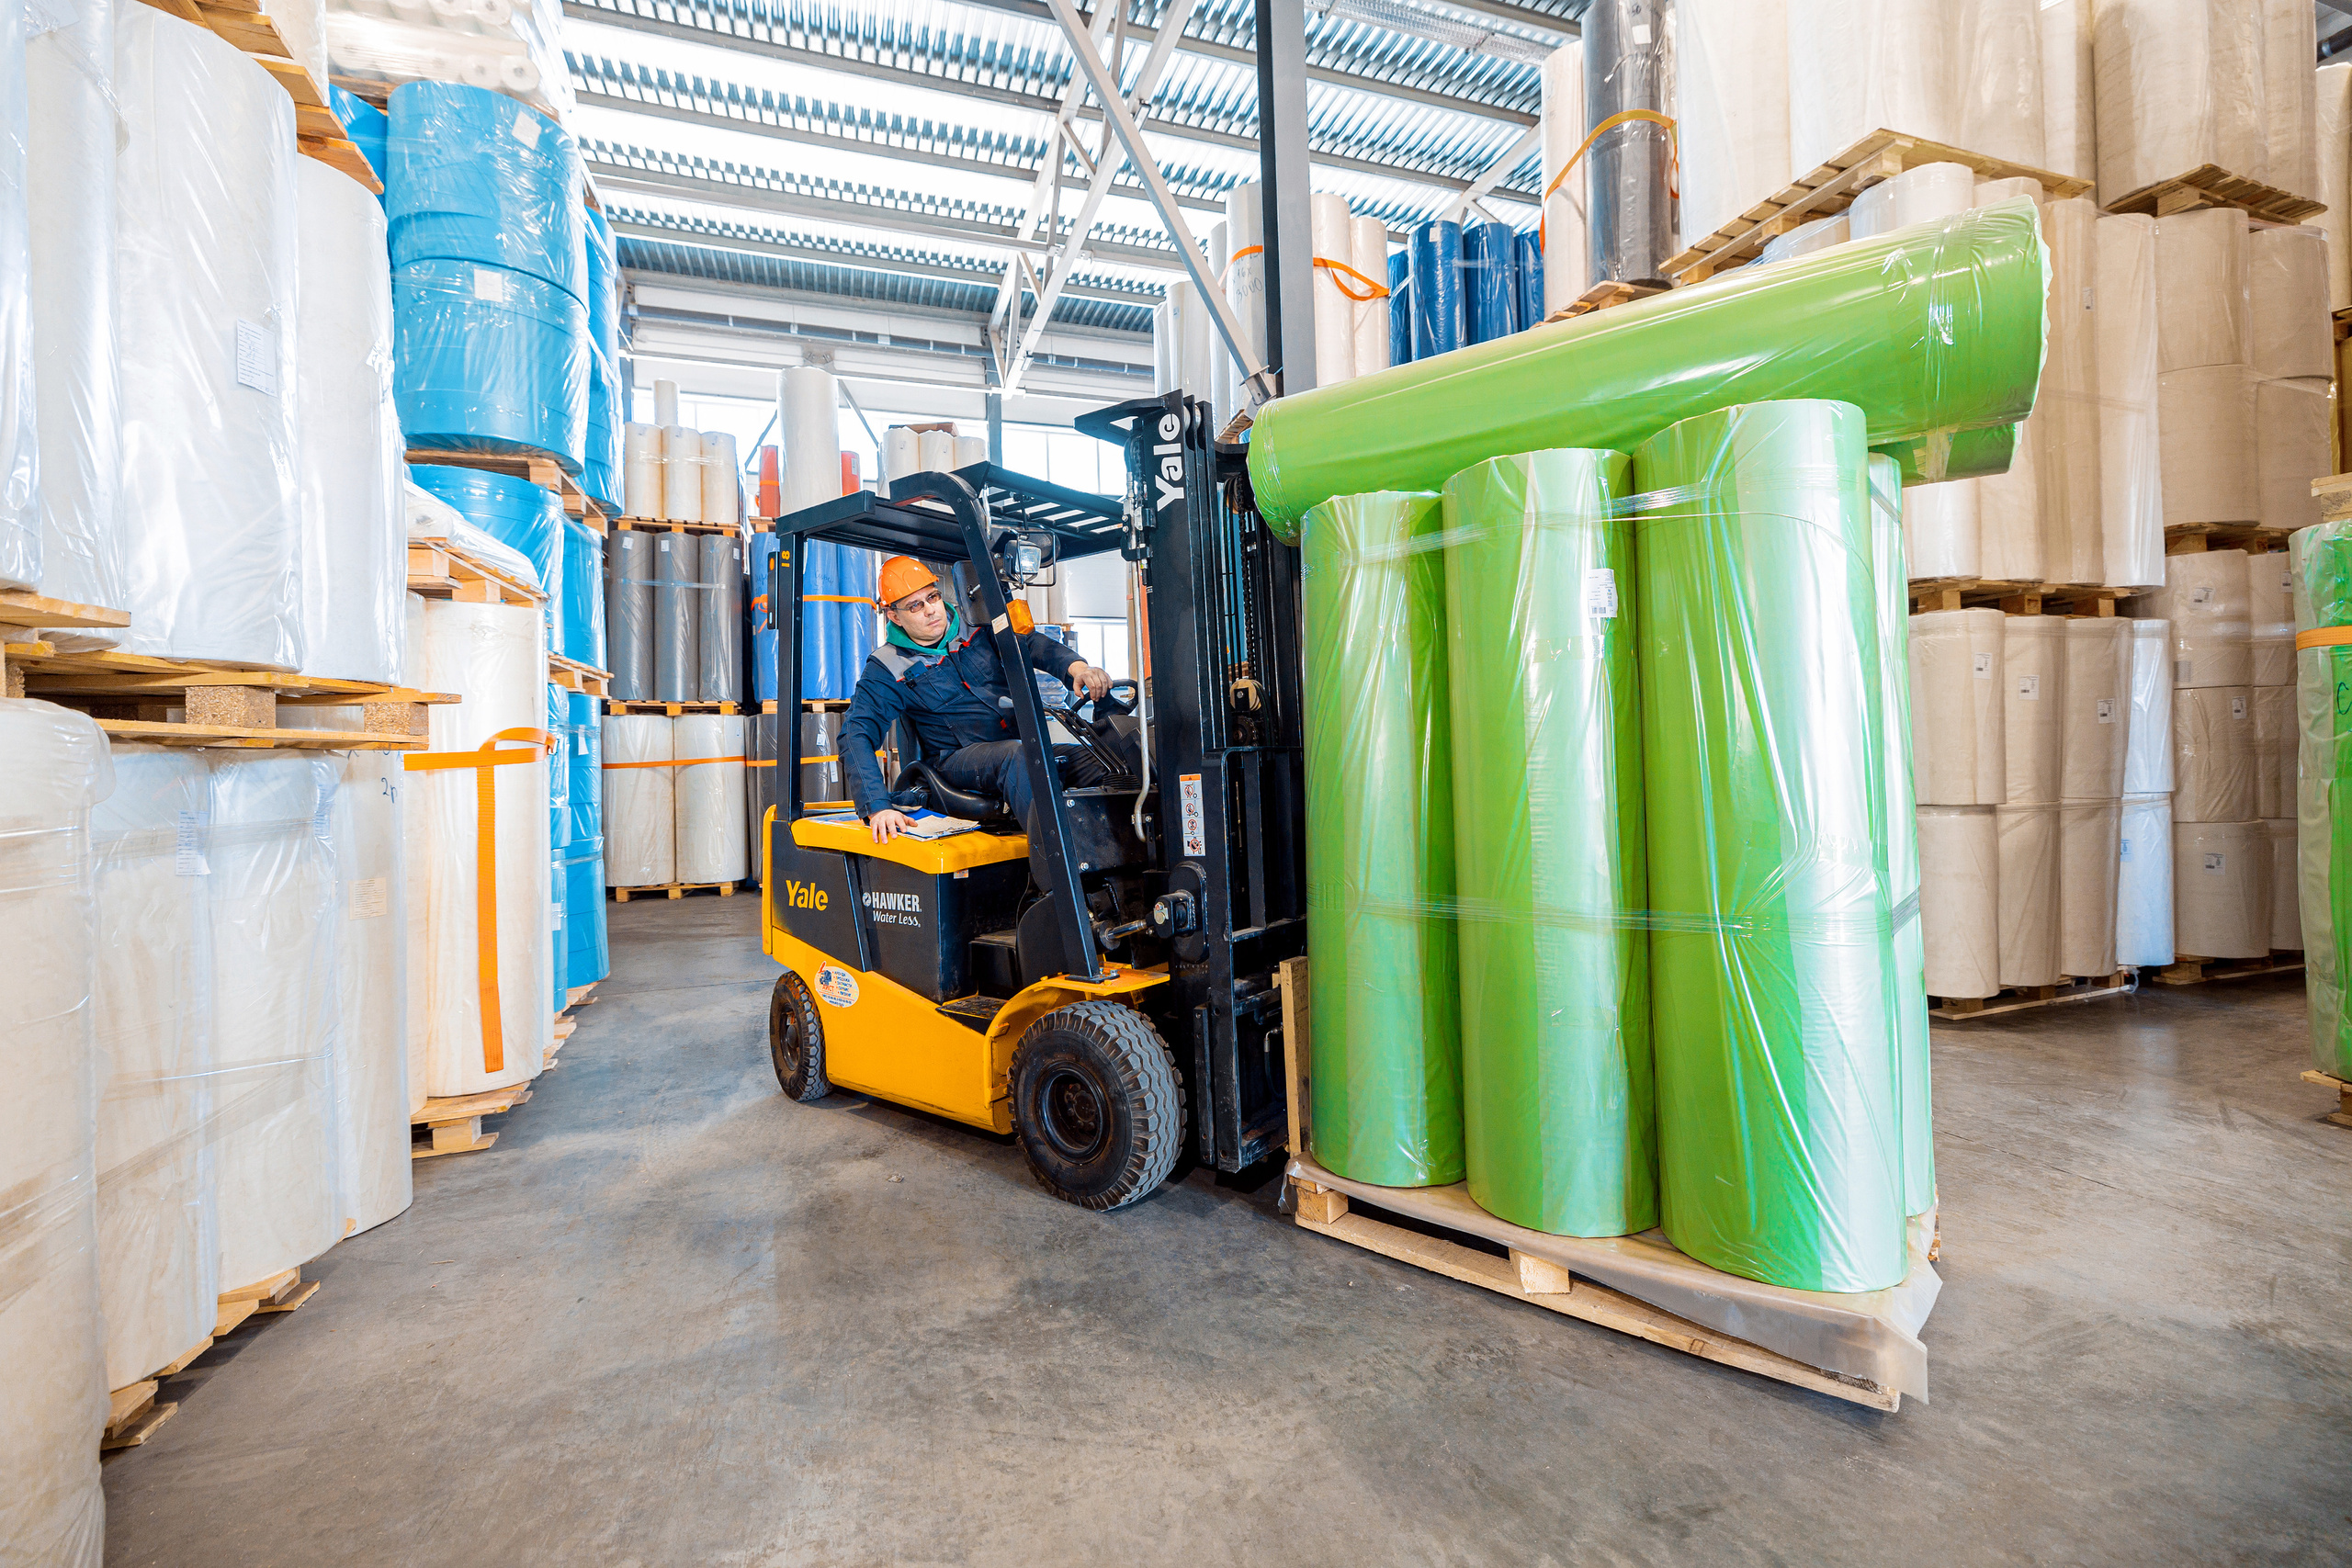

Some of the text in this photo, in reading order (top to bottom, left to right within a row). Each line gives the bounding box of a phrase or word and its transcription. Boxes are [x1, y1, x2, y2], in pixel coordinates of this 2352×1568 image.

[1236, 276, 1263, 300] 3000
[1153, 413, 1184, 512] Yale
[781, 550, 790, 568] 18
[785, 879, 829, 911] Yale
[872, 891, 921, 912] HAWKER
[873, 910, 919, 927] Water Less
